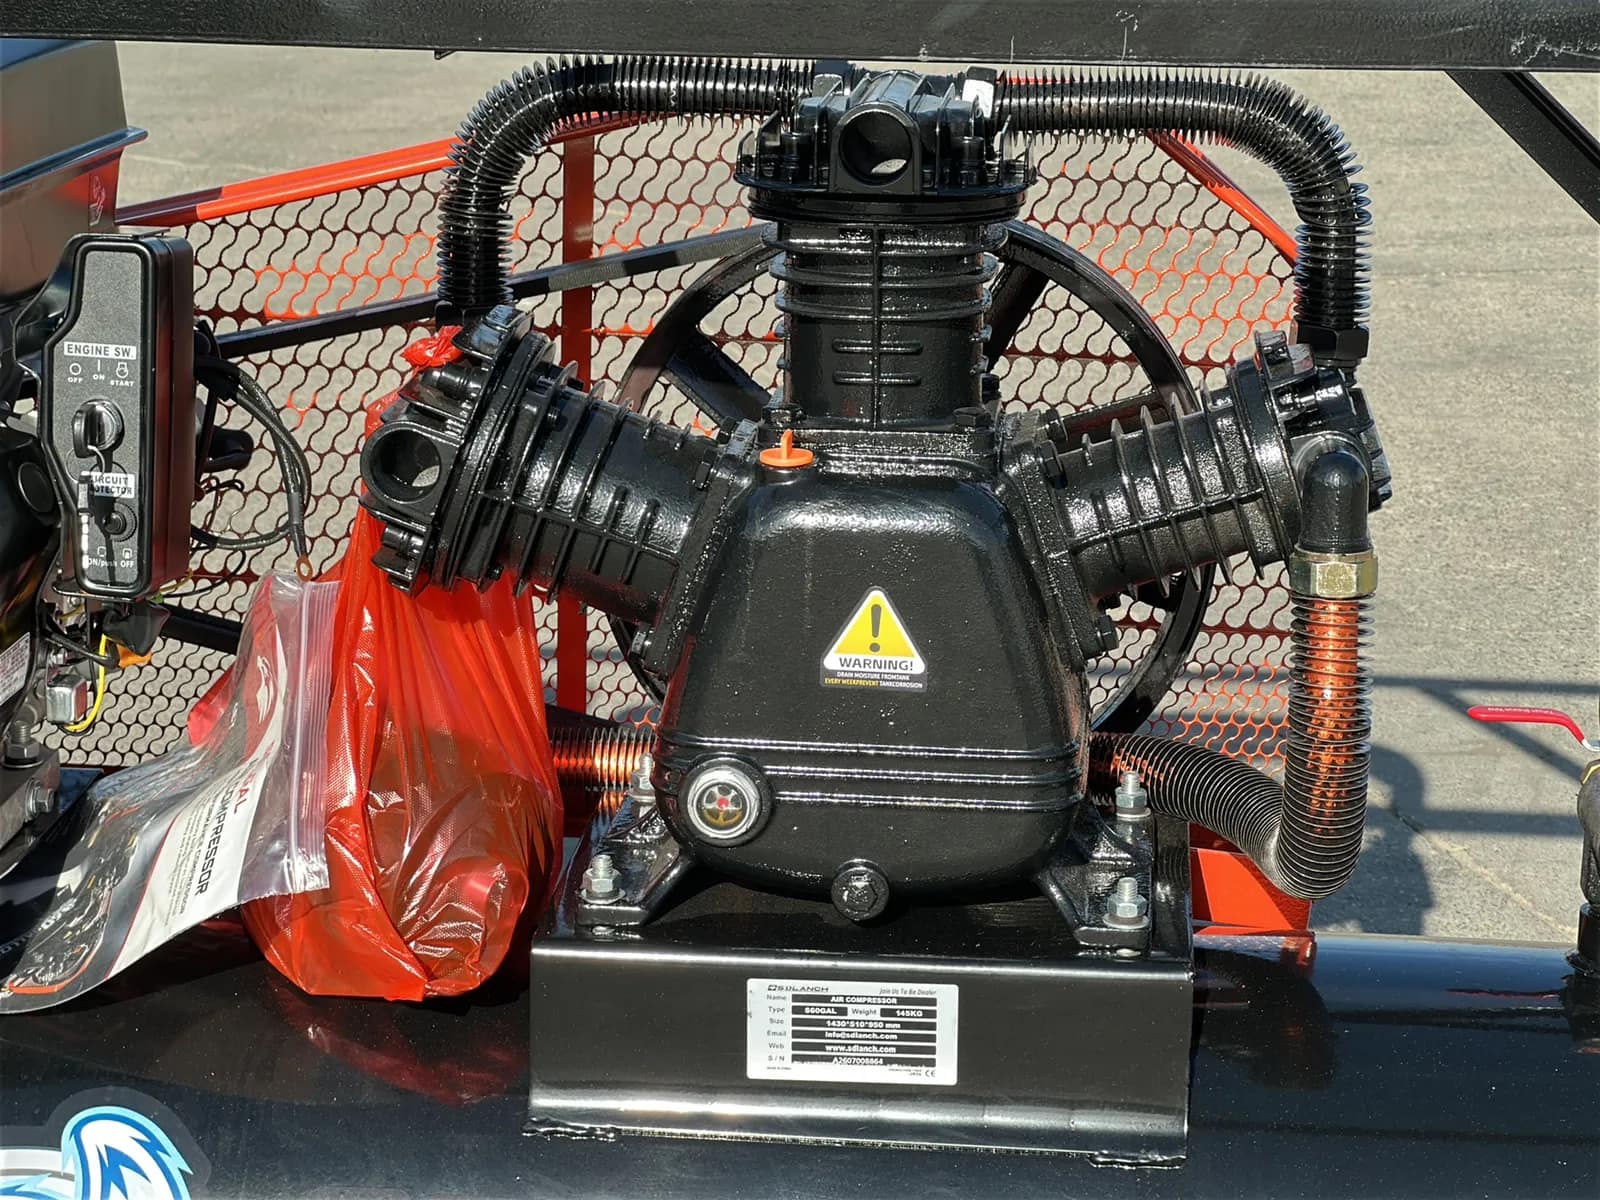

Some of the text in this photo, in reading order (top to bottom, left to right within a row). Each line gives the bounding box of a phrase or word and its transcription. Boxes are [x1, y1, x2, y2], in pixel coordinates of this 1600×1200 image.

[67, 344, 134, 358] ENGINE SW.
[95, 475, 128, 485] IRCUIT
[95, 486, 132, 495] OTECTOR
[839, 657, 913, 671] WARNING!
[845, 997, 897, 1005] COMPRESSOR
[768, 1006, 786, 1014] Type
[852, 1008, 877, 1016] Weight
[825, 1044, 897, 1053] www.sdlanch.com
